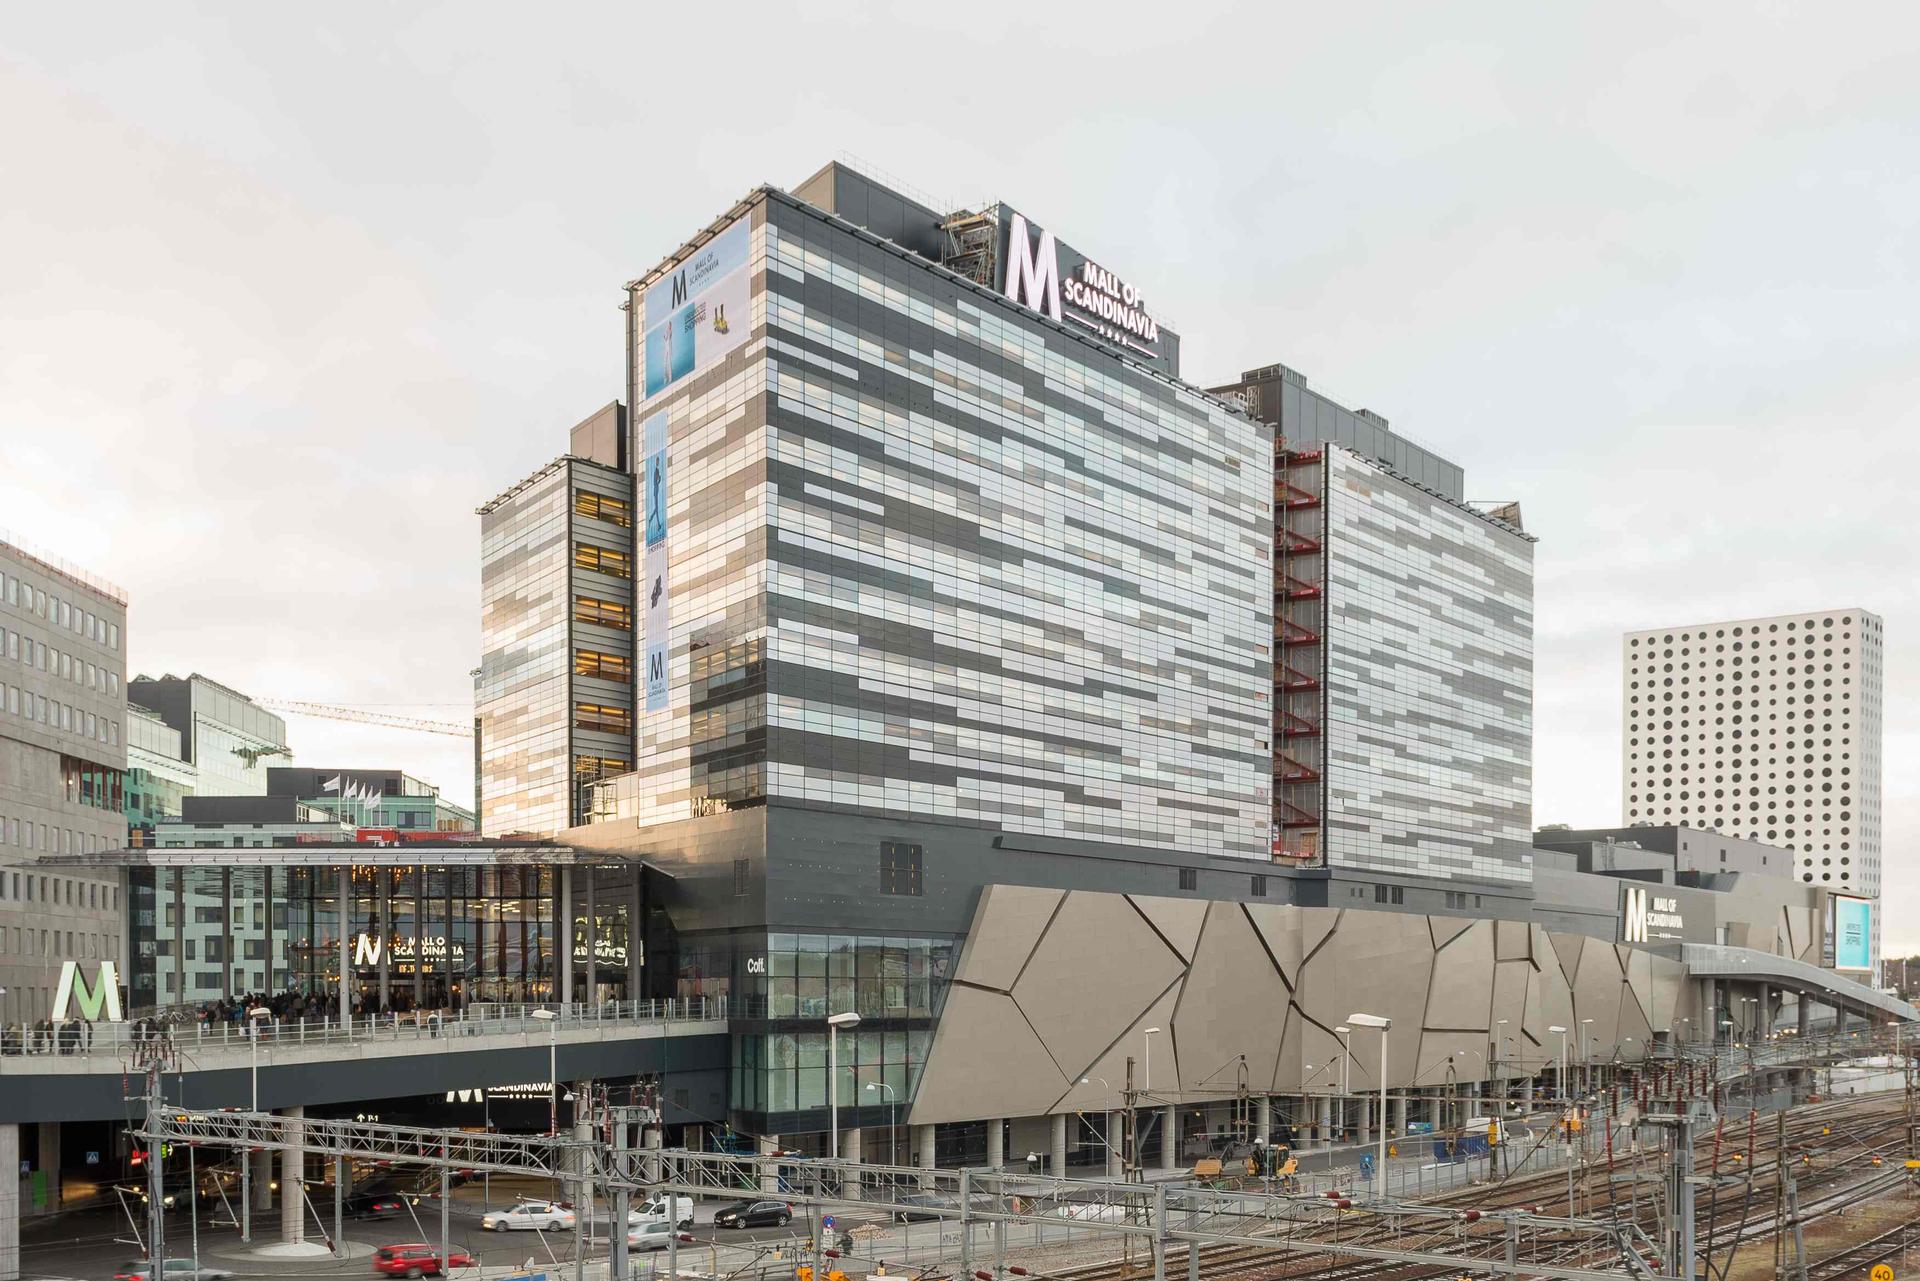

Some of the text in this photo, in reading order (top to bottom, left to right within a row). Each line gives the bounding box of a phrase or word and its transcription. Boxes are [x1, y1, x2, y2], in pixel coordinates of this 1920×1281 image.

[1004, 212, 1062, 323] M
[1083, 261, 1142, 307] MALL OF
[672, 269, 688, 310] M
[1064, 277, 1158, 343] SCANDINAVIA
[650, 651, 663, 682] M
[1625, 888, 1648, 942] M
[394, 945, 464, 956] SCADINAIA
[747, 957, 765, 974] Coff.
[52, 961, 122, 1021] M
[1875, 1269, 1891, 1281] 40
